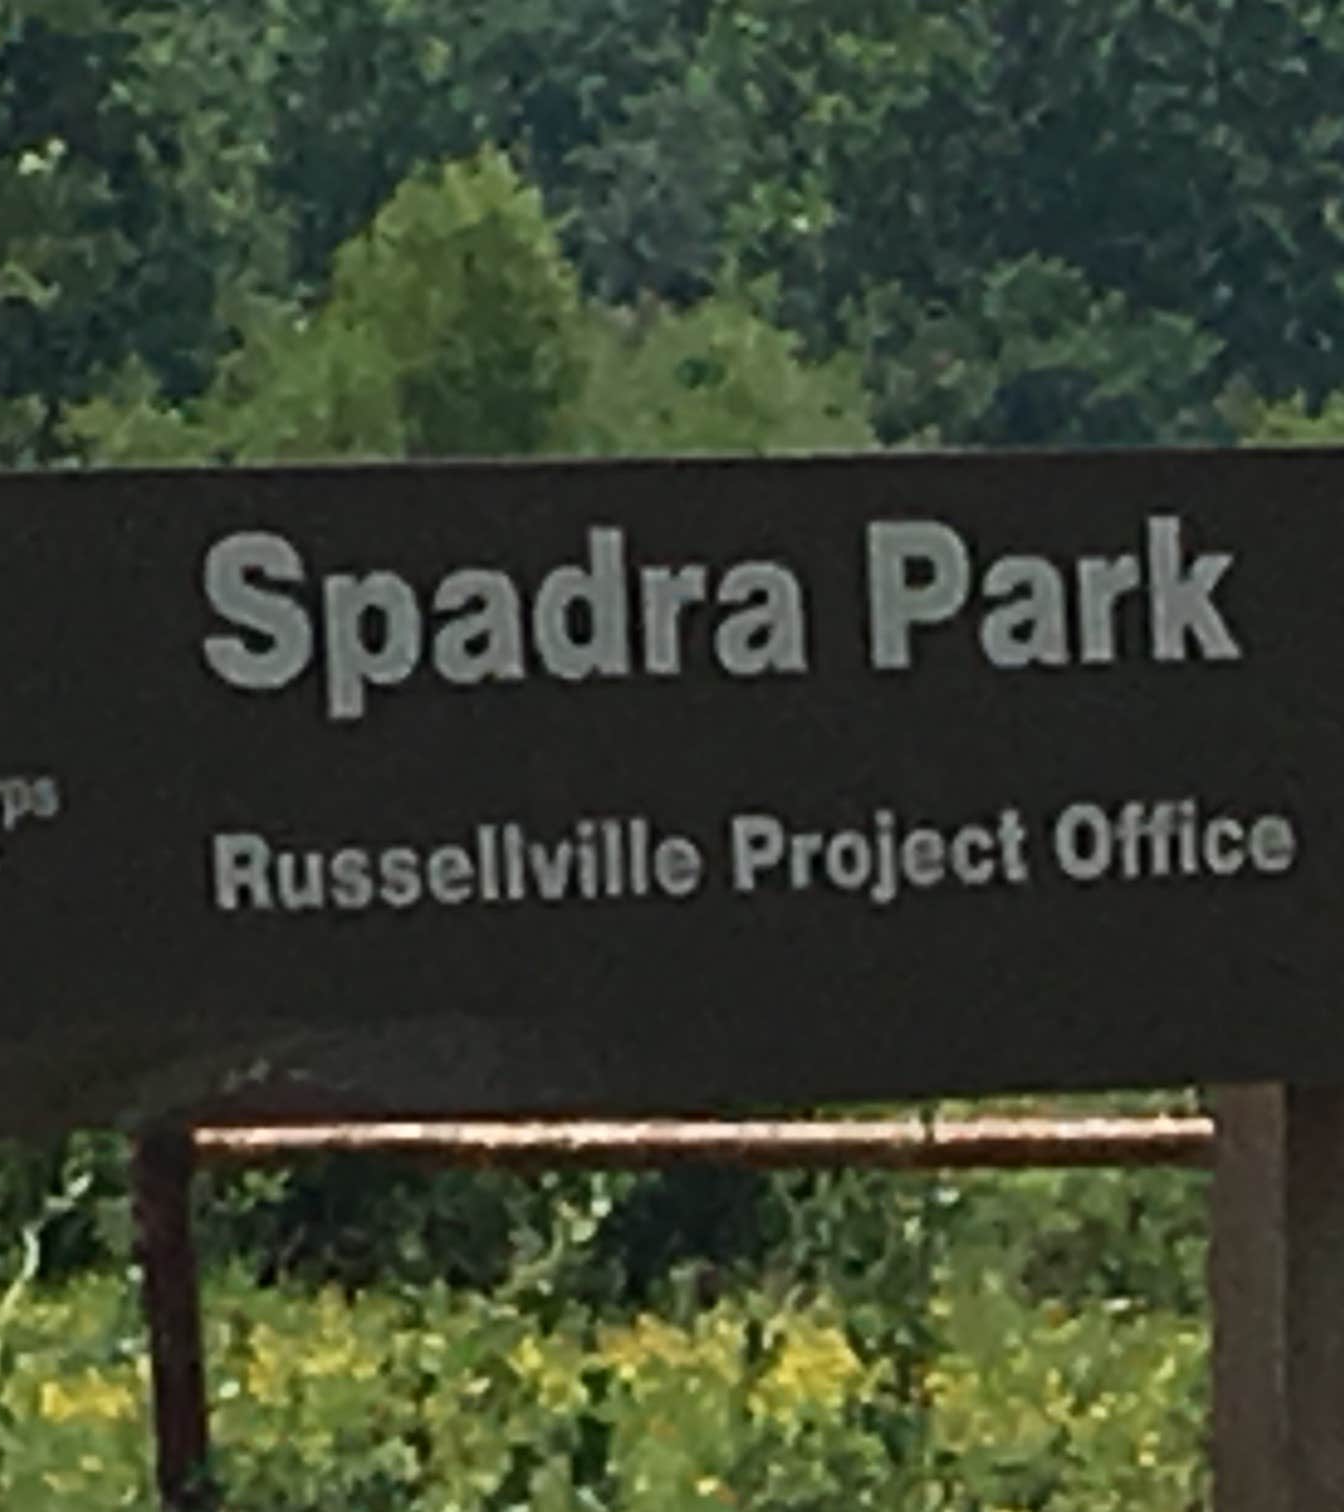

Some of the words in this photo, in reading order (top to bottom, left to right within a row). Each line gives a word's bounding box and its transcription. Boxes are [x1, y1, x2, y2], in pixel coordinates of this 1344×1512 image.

[203, 526, 807, 719] Spadra
[868, 515, 1240, 668] Park
[214, 818, 701, 915] Russellville
[732, 809, 1027, 903] Project
[1055, 799, 1294, 879] Office
